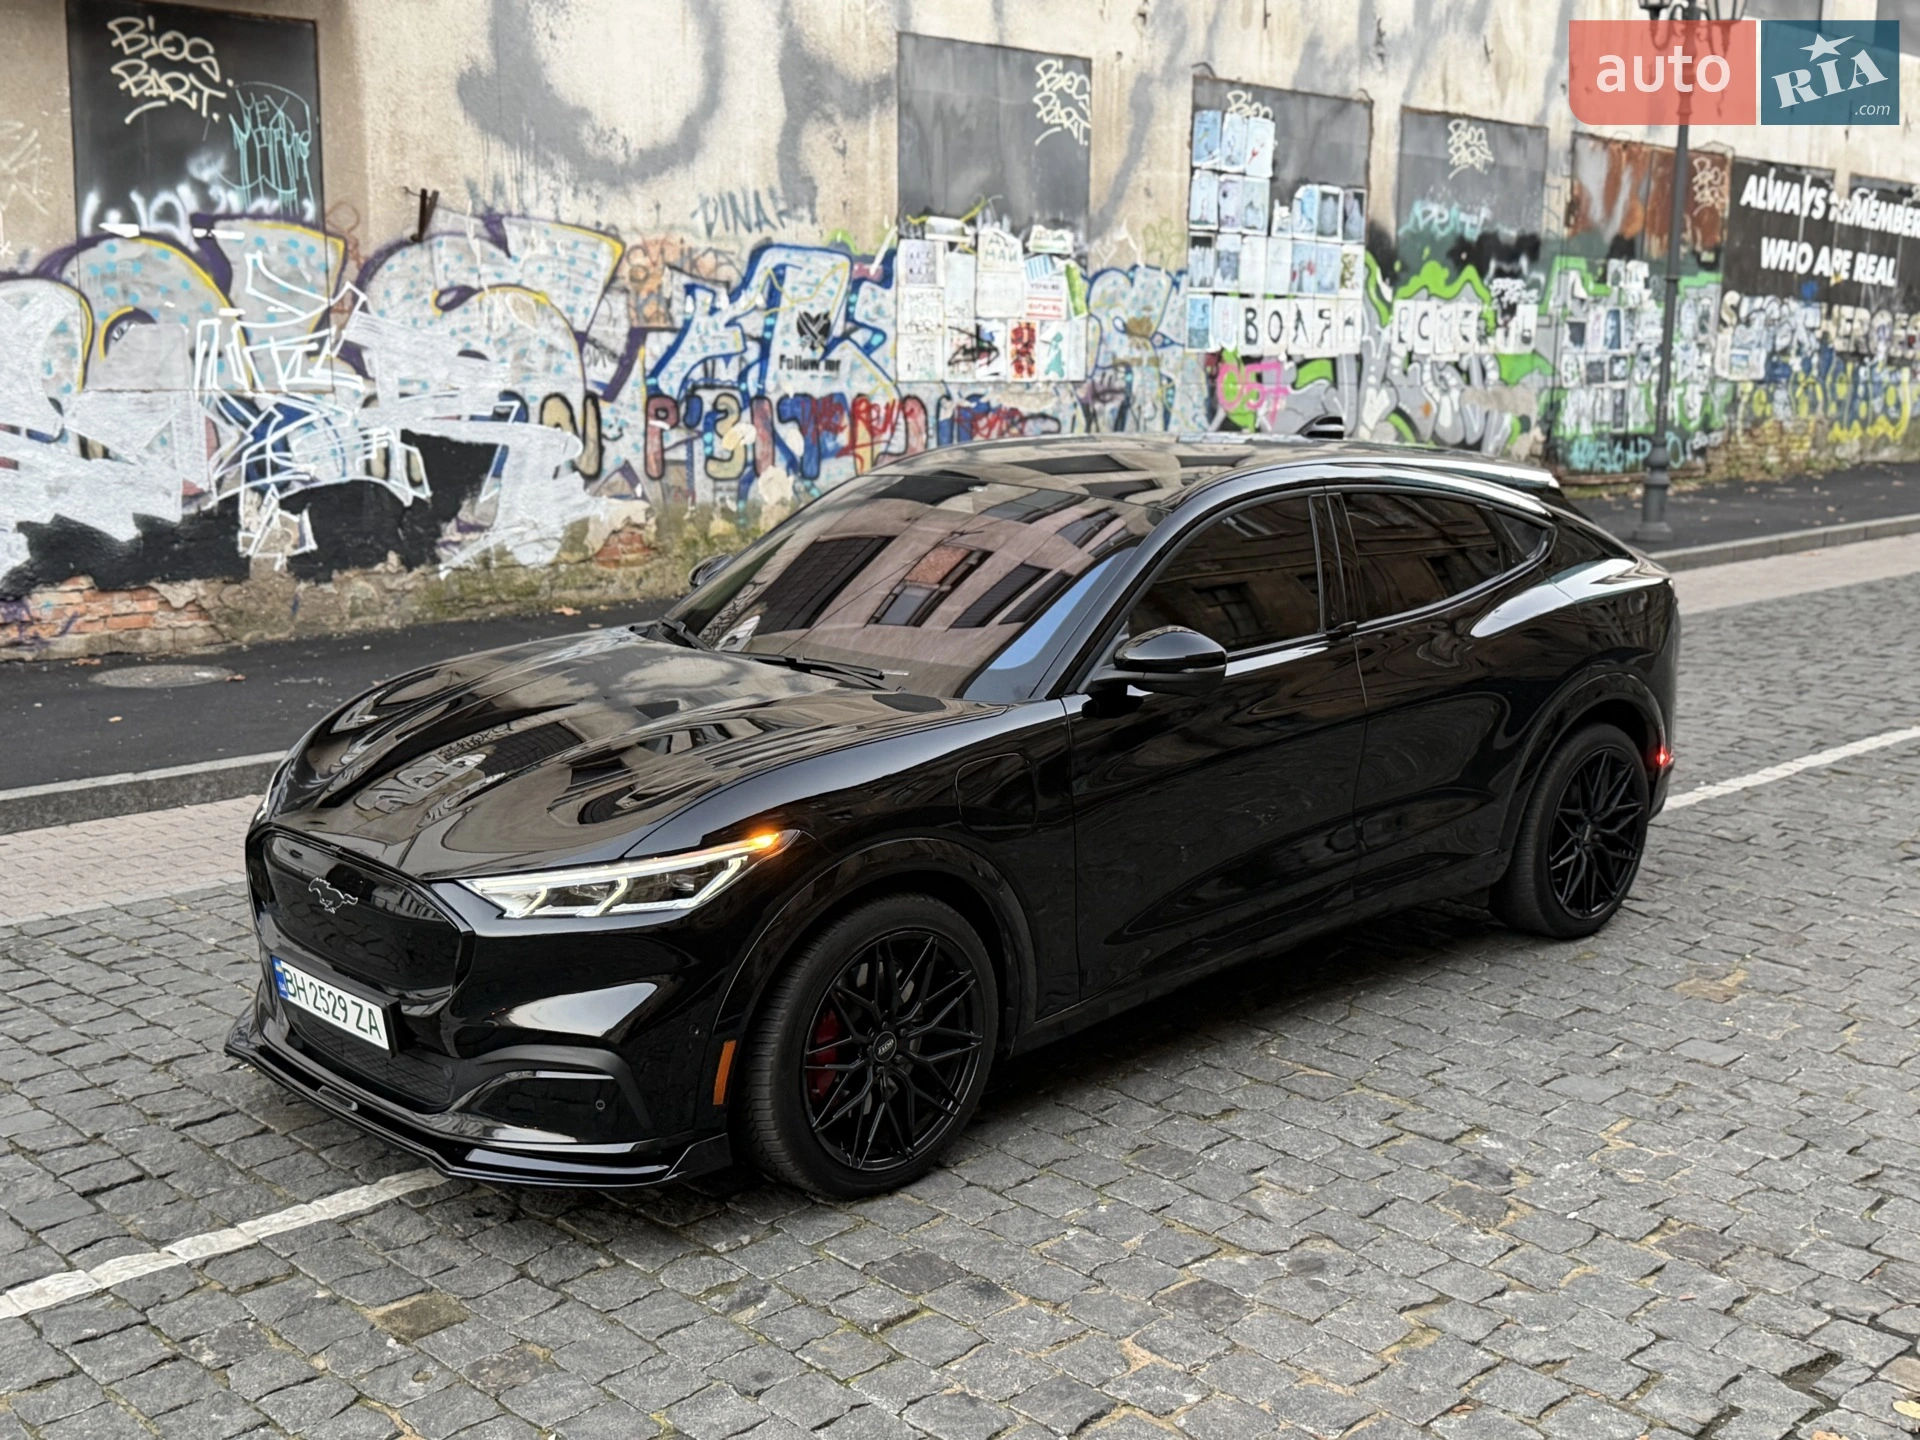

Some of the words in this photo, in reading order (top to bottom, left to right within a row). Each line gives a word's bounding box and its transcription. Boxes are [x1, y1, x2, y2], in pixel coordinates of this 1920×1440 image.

[1739, 167, 1828, 220] ALWAYS
[1760, 236, 1814, 275] WHO
[1812, 245, 1853, 281] ARE
[1852, 251, 1897, 287] REAL
[779, 354, 820, 371] Follow
[283, 967, 309, 1005] BH
[309, 981, 348, 1023] 2529
[351, 999, 382, 1040] ZA
